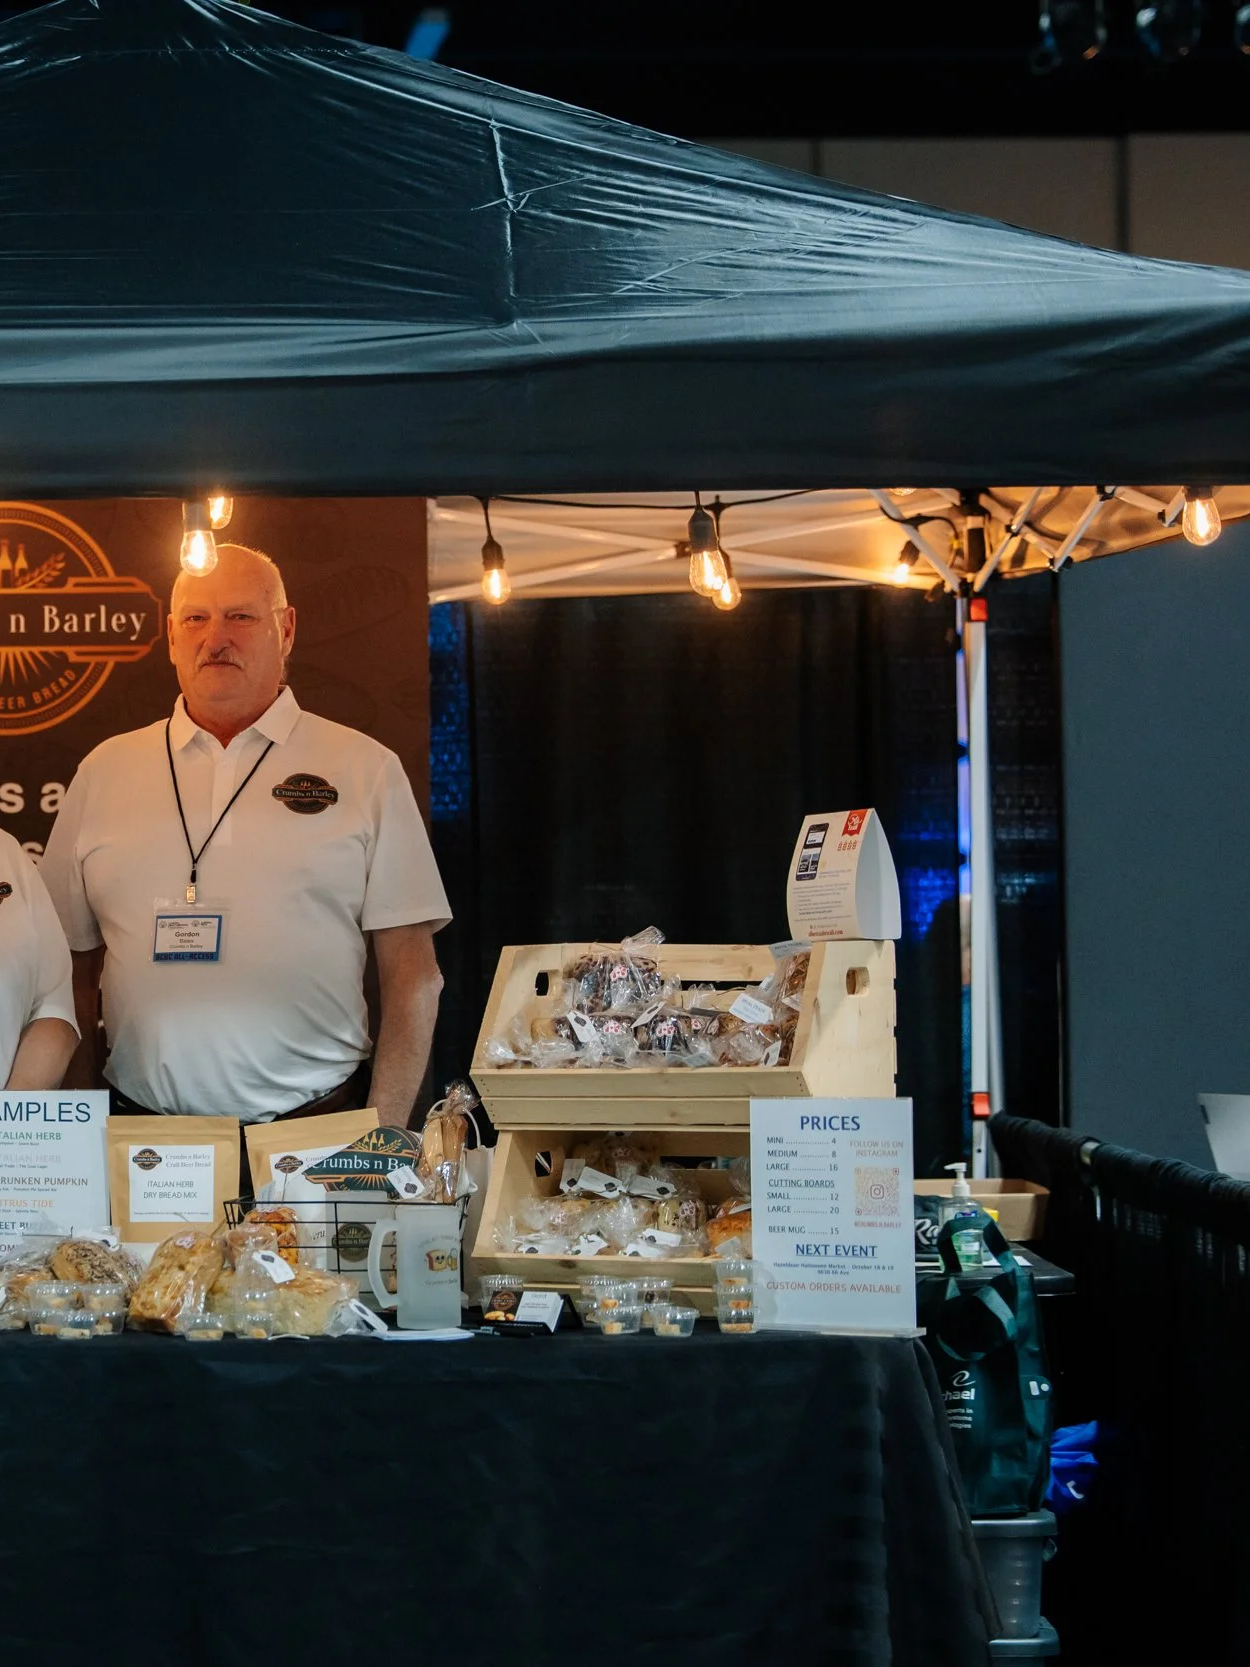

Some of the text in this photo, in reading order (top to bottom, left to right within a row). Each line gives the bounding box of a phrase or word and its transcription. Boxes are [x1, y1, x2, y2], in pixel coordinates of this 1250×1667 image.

[9, 613, 26, 634] n
[43, 605, 146, 641] Barley
[33, 668, 77, 704] BREAD
[800, 1116, 861, 1131] PRICES
[36, 1132, 61, 1140] HERB
[767, 1137, 836, 1145] MINI 4
[892, 1141, 904, 1149] ON
[767, 1150, 798, 1158] MEDIUM
[374, 1160, 383, 1169] n
[766, 1163, 838, 1172] LARGE 16
[44, 1178, 88, 1186] PUMPKIN
[768, 1179, 835, 1188] CUTTING BOARDS
[767, 1192, 791, 1200] SMALL
[33, 1200, 55, 1208] TIDE
[830, 1206, 839, 1214] 20
[768, 1226, 839, 1235] BEER MUG 15
[796, 1244, 878, 1257] NEXT EVENT
[767, 1281, 902, 1293] CUSTOM ORDERS AVAILABLE
